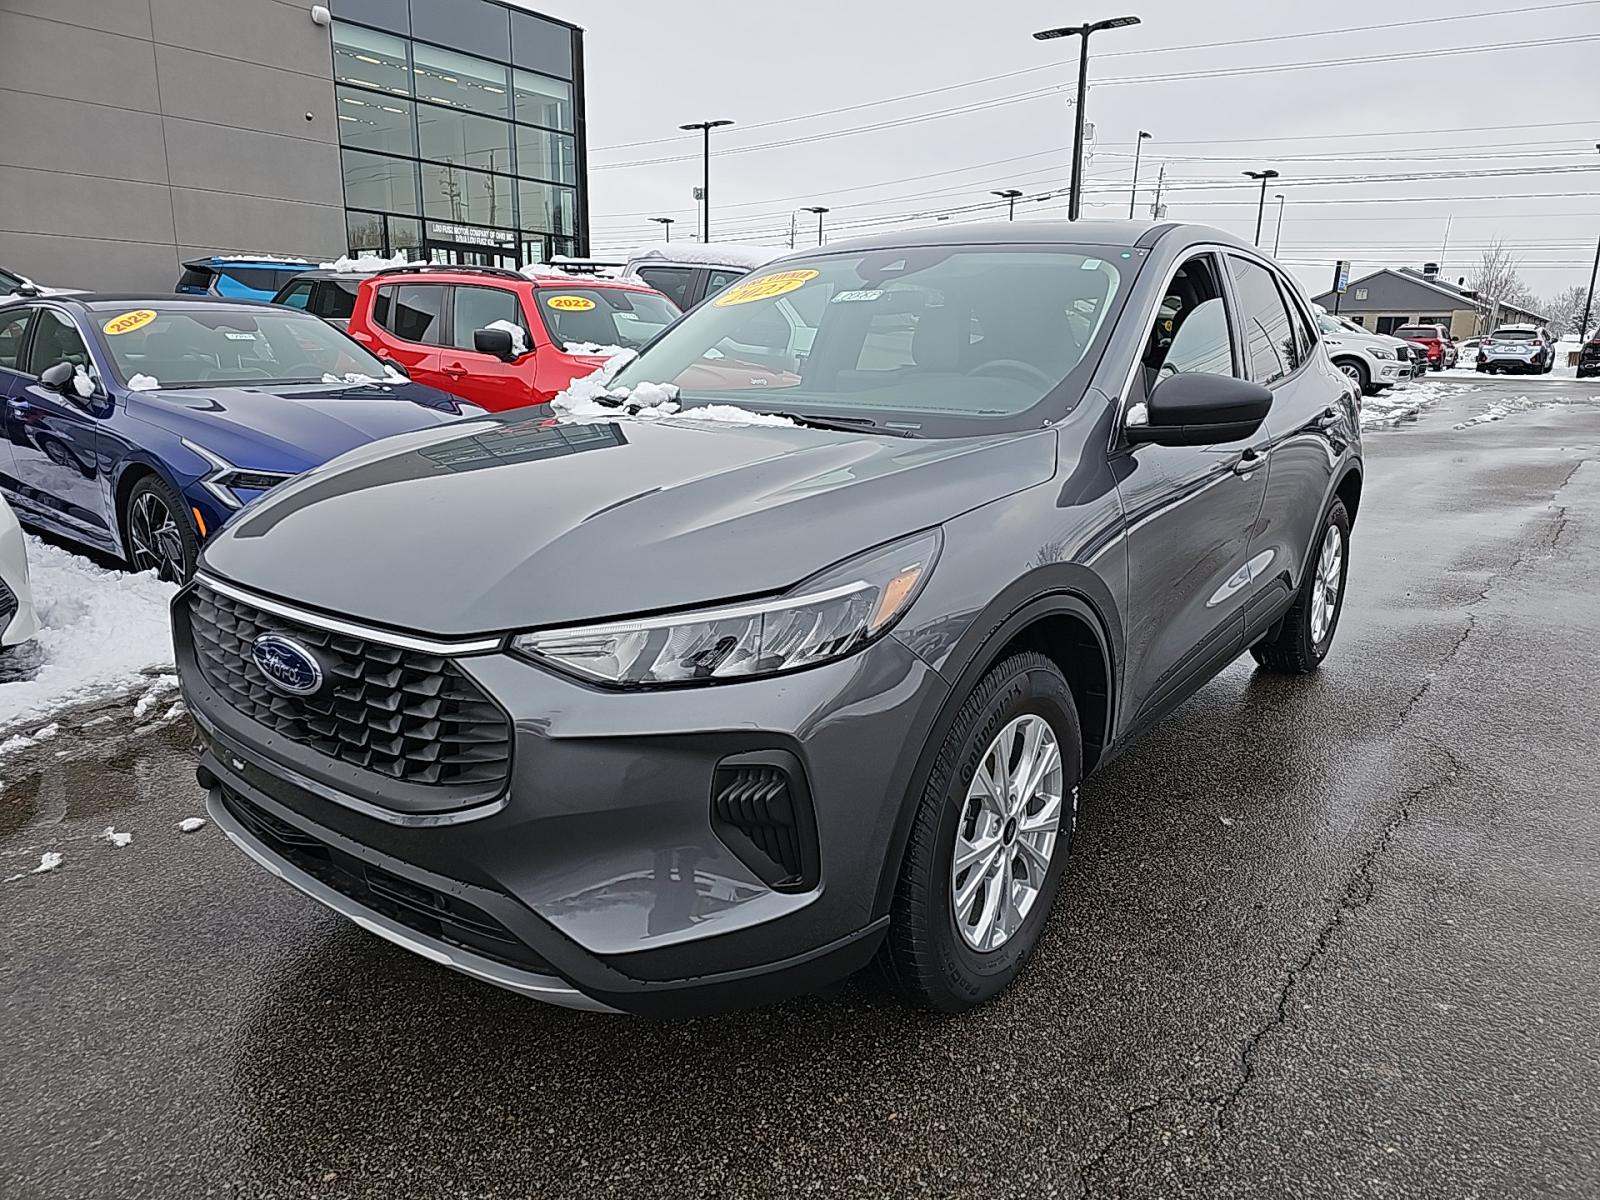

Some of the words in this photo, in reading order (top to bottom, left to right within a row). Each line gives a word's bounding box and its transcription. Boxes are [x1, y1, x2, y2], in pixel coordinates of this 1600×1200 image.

[432, 223, 442, 233] LOU
[469, 228, 490, 237] COMPANY
[489, 230, 496, 239] OF
[495, 231, 506, 241] OHIO
[467, 236, 476, 245] LOU
[554, 299, 591, 308] 2022
[110, 311, 151, 333] 2025
[258, 645, 302, 684] Ford
